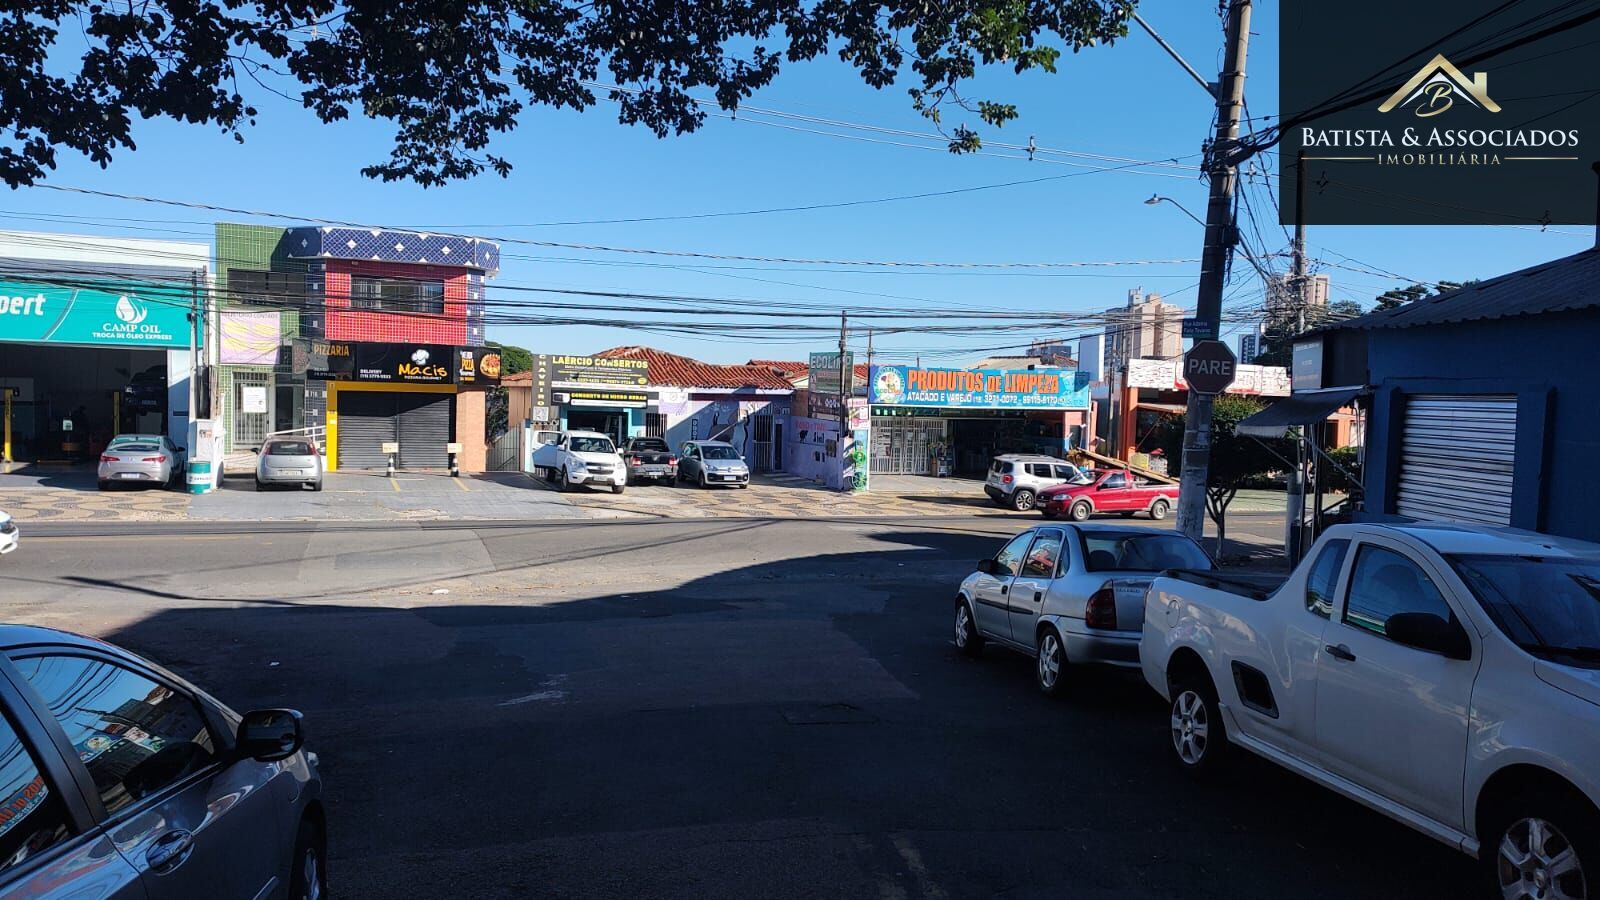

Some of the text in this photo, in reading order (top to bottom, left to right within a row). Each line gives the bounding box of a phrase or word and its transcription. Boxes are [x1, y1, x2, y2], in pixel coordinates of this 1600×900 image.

[102, 322, 161, 334] CAMP OIL
[313, 344, 350, 357] PIZZARIA
[552, 355, 593, 366] LAÉRCIO
[594, 357, 648, 369] CONSERTOS
[1188, 358, 1232, 376] PARE
[398, 363, 448, 377] Macis
[907, 369, 984, 392] PRODUTOS
[987, 375, 1002, 393] DE
[1004, 373, 1059, 394] LIMPEZA
[906, 392, 939, 402] ATACADO
[940, 393, 945, 402] E
[946, 393, 972, 403] VAREJO
